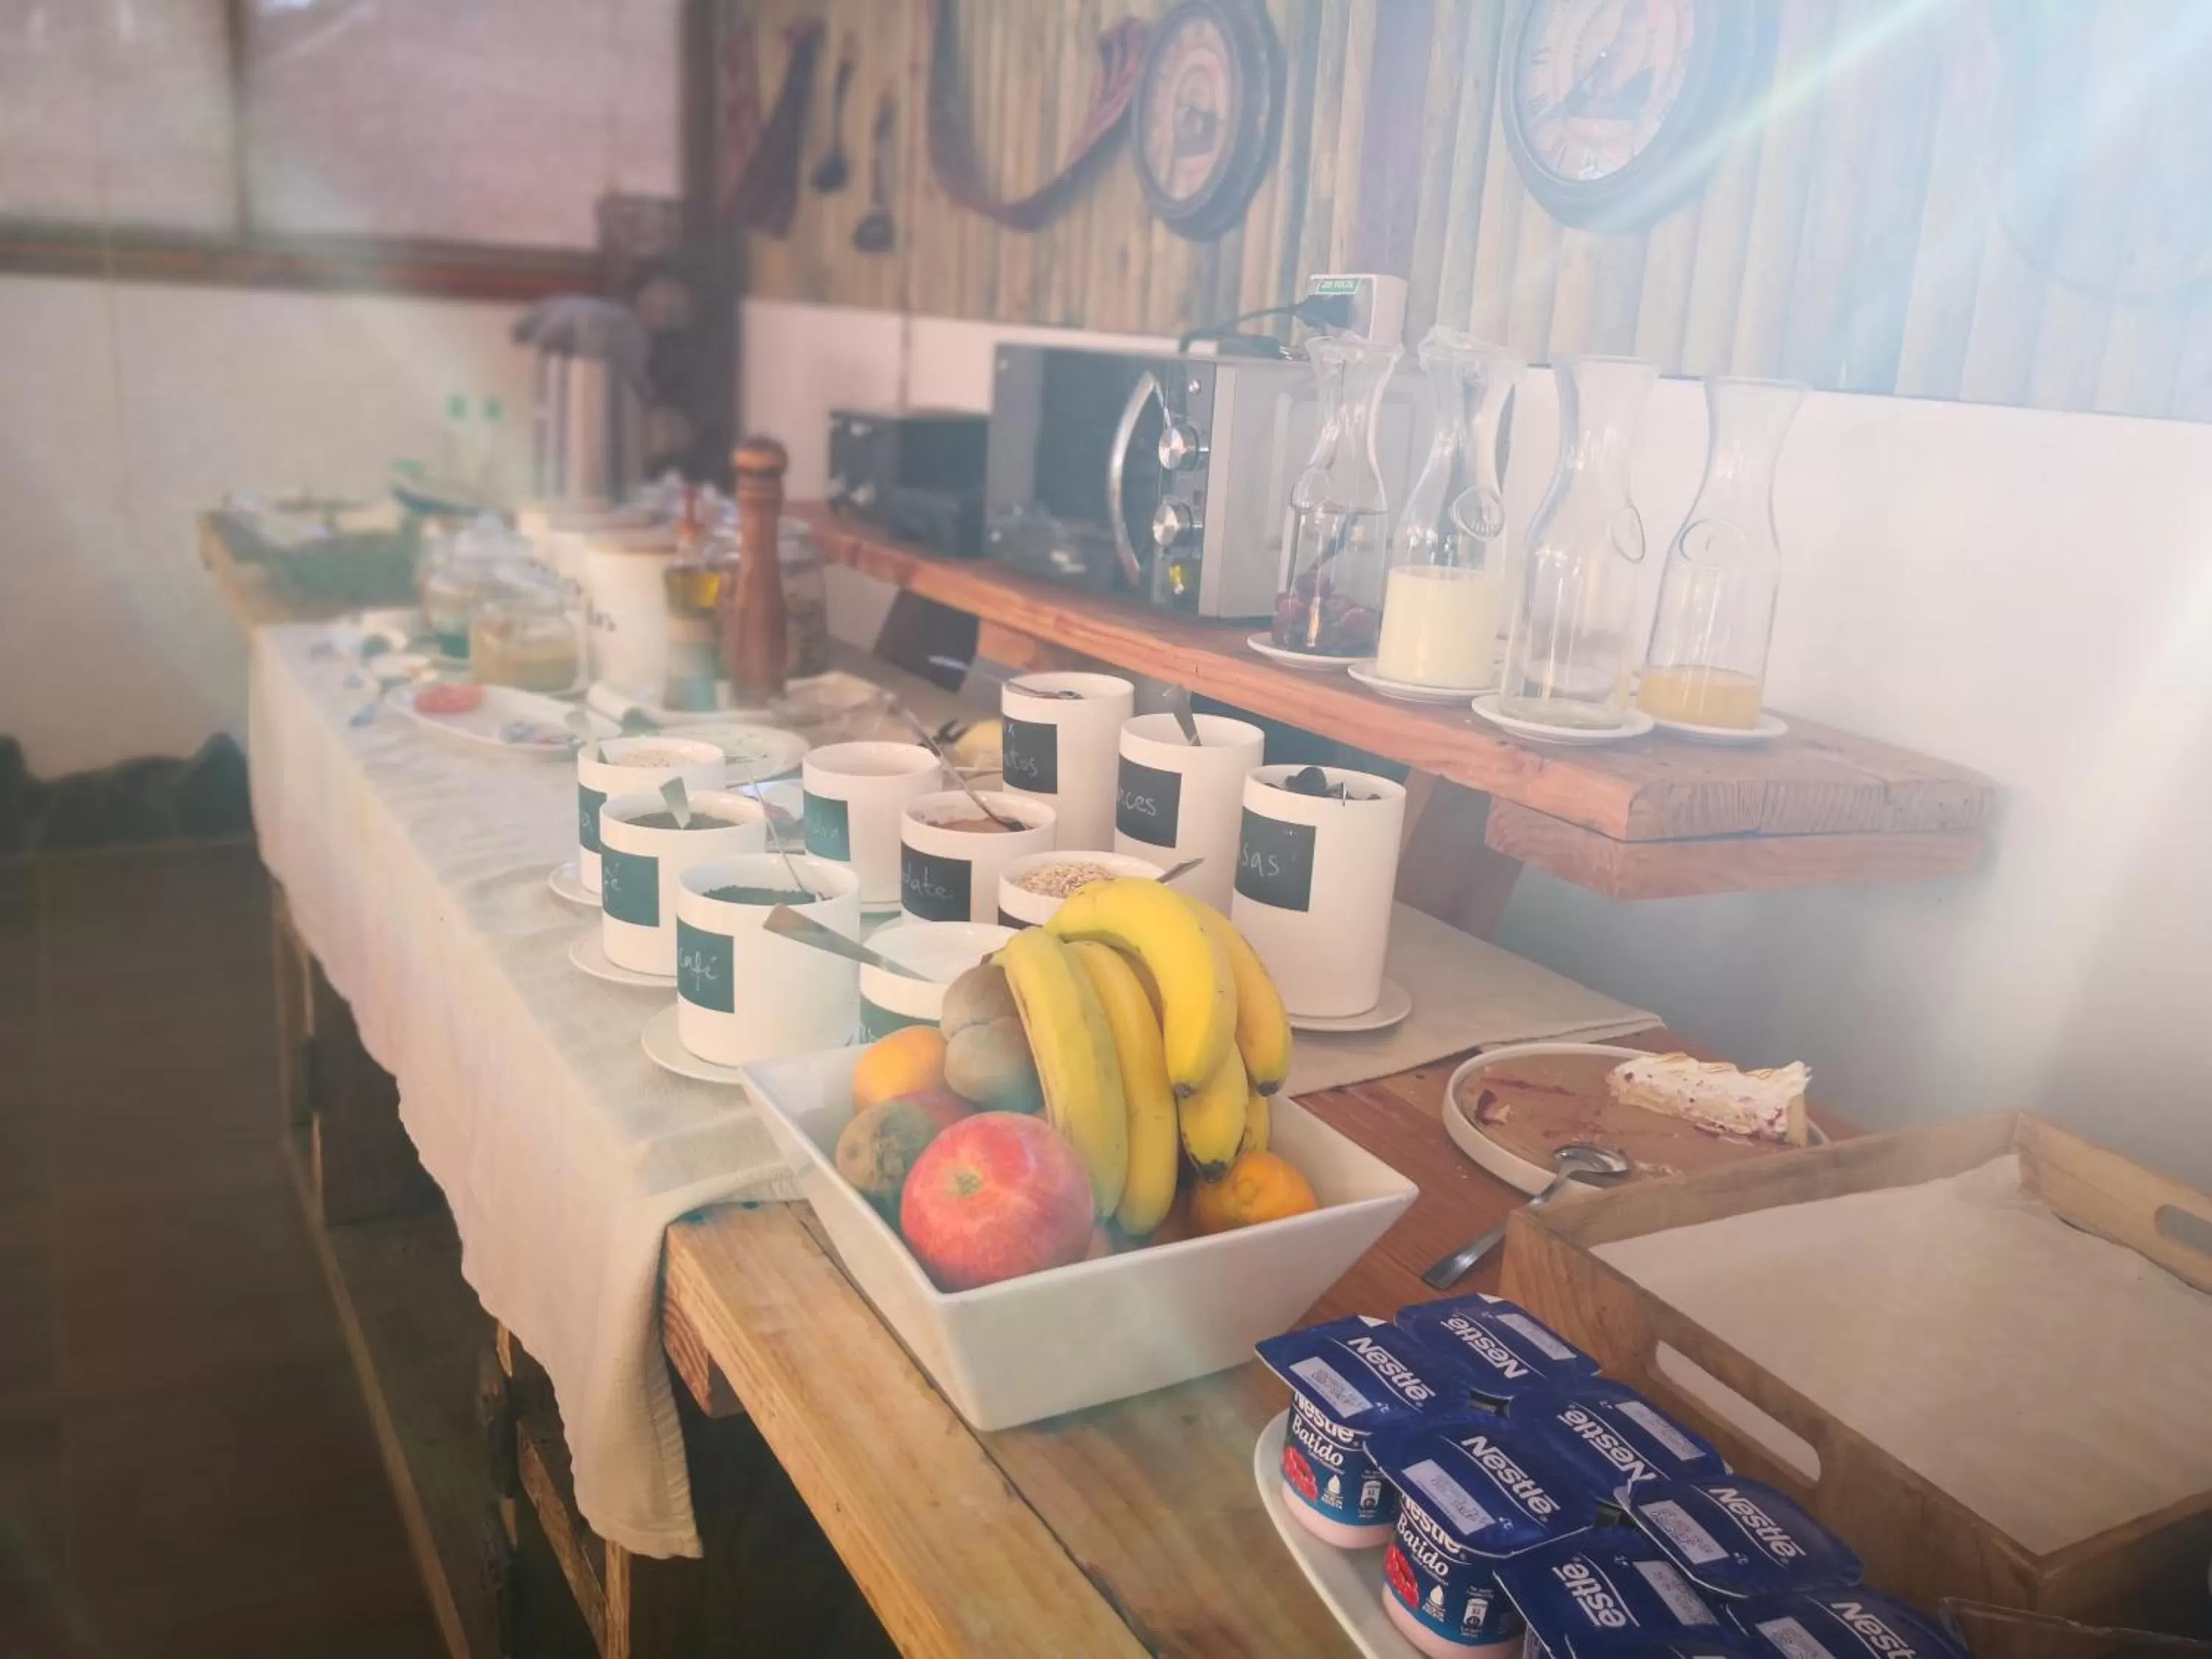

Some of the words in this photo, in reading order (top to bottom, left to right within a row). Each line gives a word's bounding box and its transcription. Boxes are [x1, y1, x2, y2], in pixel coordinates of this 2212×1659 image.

[1292, 1413, 1344, 1466] Batido
[1397, 1512, 1449, 1576] Batido
[1830, 1601, 1917, 1659] Nest
